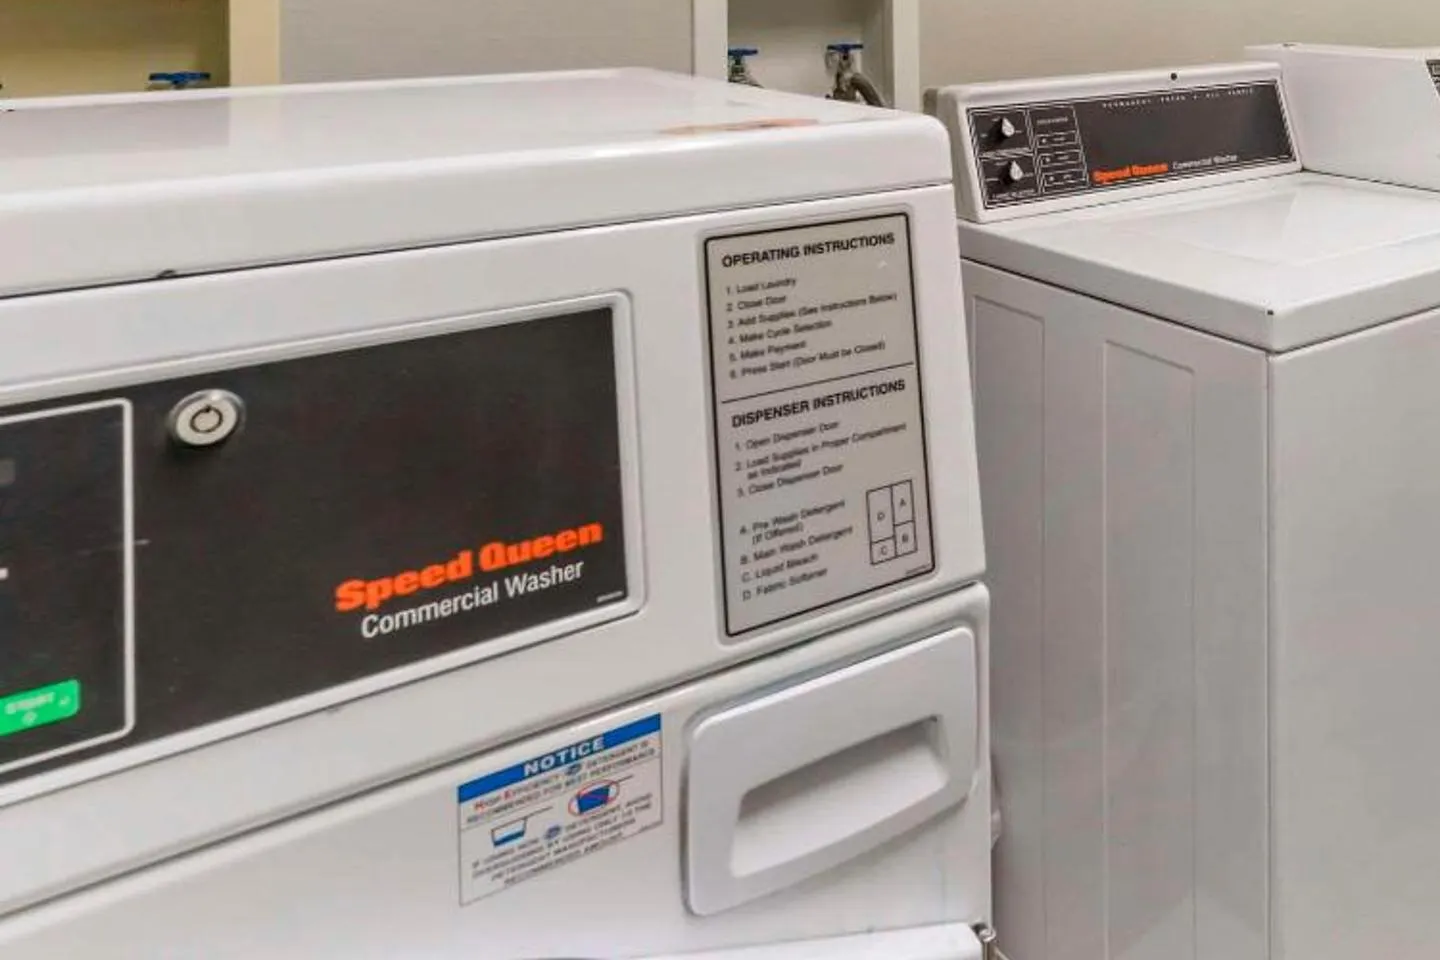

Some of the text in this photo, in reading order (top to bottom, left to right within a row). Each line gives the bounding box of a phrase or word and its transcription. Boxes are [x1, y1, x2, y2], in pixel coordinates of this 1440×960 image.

[721, 231, 894, 268] OPERATING INSTRUCTIONS
[736, 282, 759, 294] Load
[761, 277, 796, 290] Laundry
[737, 298, 762, 310] Close
[765, 294, 786, 305] Door
[737, 315, 756, 327] Add
[759, 308, 795, 324] Supplies
[797, 305, 818, 317] (See
[819, 296, 866, 313] Instructions
[868, 291, 897, 304] Below)
[739, 331, 764, 344] Make
[766, 326, 790, 339] Cycle
[793, 319, 832, 334] Selection
[740, 347, 764, 360] Make
[767, 339, 806, 355] Payment
[740, 363, 767, 377] Press
[769, 358, 790, 372] Start
[792, 353, 816, 367] (Door
[818, 349, 839, 361] Must
[840, 346, 851, 357] be
[853, 340, 885, 354] Closed)
[731, 377, 905, 428] DISPENSER INSTRUCTIONS
[745, 435, 770, 450] Open
[772, 424, 815, 444] Dispenser
[819, 419, 839, 432] Door
[746, 455, 768, 469] Load
[771, 445, 808, 462] Supplies
[821, 435, 849, 450] Proper
[851, 421, 906, 442] Compartment
[748, 479, 774, 495] Close
[776, 467, 819, 488] Dispenser
[822, 461, 843, 475] Door
[760, 458, 801, 477] Indicated
[751, 519, 768, 534] Pre
[772, 511, 798, 528] Wash
[800, 498, 845, 520] Detergent
[764, 521, 803, 541] Offered)
[753, 546, 776, 563] Main
[779, 538, 806, 555] Wash
[807, 524, 852, 546] Detergent
[335, 521, 604, 612] Speed Queen
[754, 562, 784, 579] Liquid
[786, 551, 818, 570] Bleach
[755, 578, 786, 597] Fabric
[788, 565, 827, 586] Softener
[360, 560, 585, 638] Commercial Washer
[523, 735, 604, 777] NOTICE
